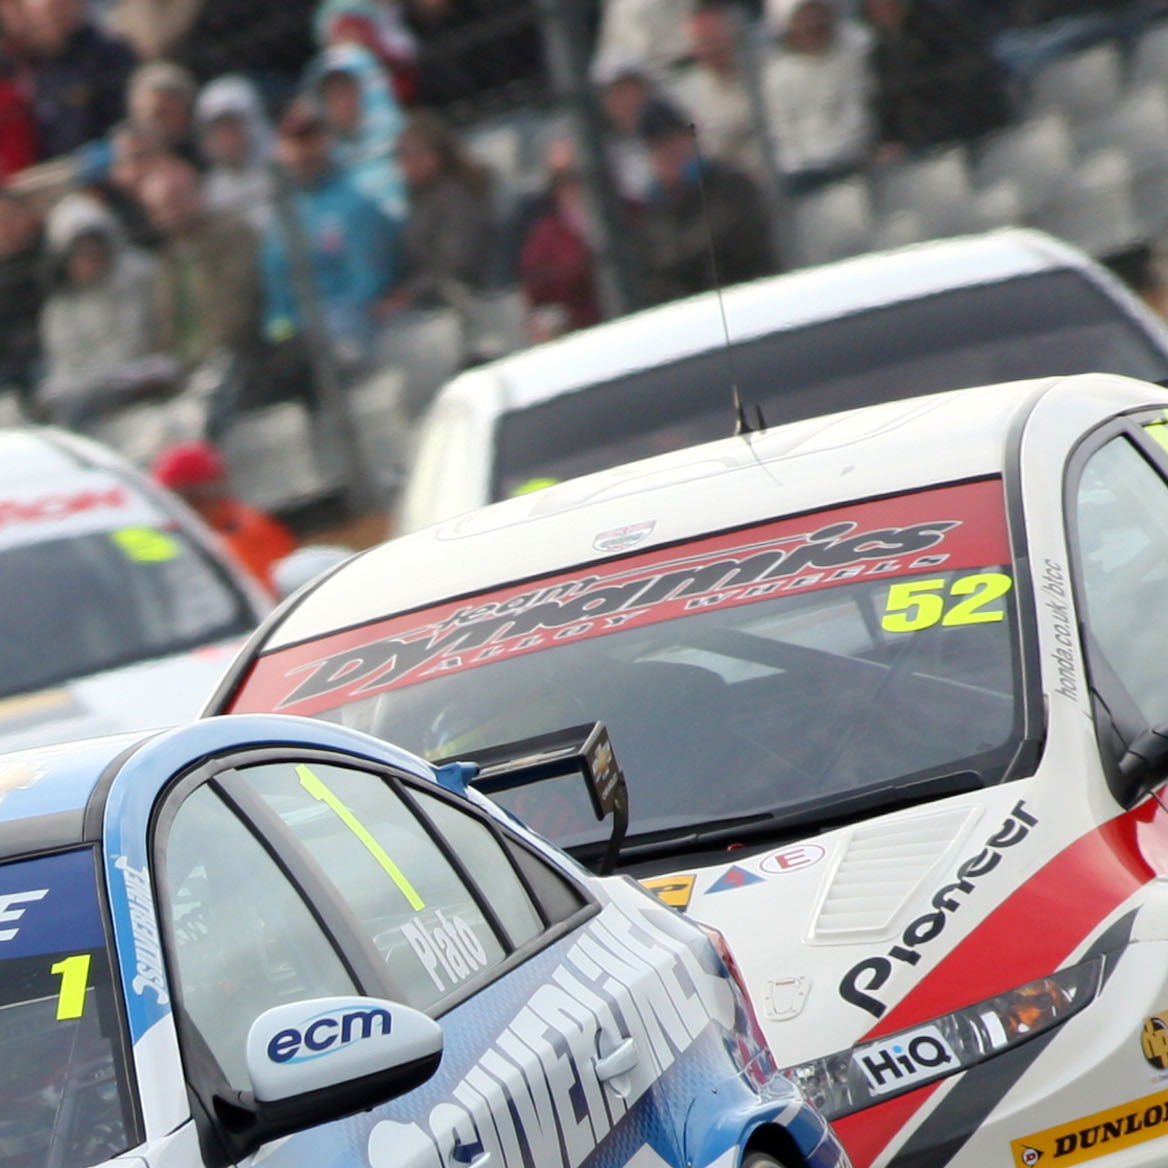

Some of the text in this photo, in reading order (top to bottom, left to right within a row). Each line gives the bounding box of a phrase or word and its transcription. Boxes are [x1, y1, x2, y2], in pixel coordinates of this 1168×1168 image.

[683, 554, 950, 611] WHEELS
[880, 573, 1013, 632] 52
[295, 764, 427, 911] 1
[400, 909, 488, 992] Plato
[51, 953, 92, 1020] 1
[267, 1008, 392, 1063] ecm
[861, 1035, 952, 1085] HiQ
[1053, 1100, 1168, 1158] DUNLO
